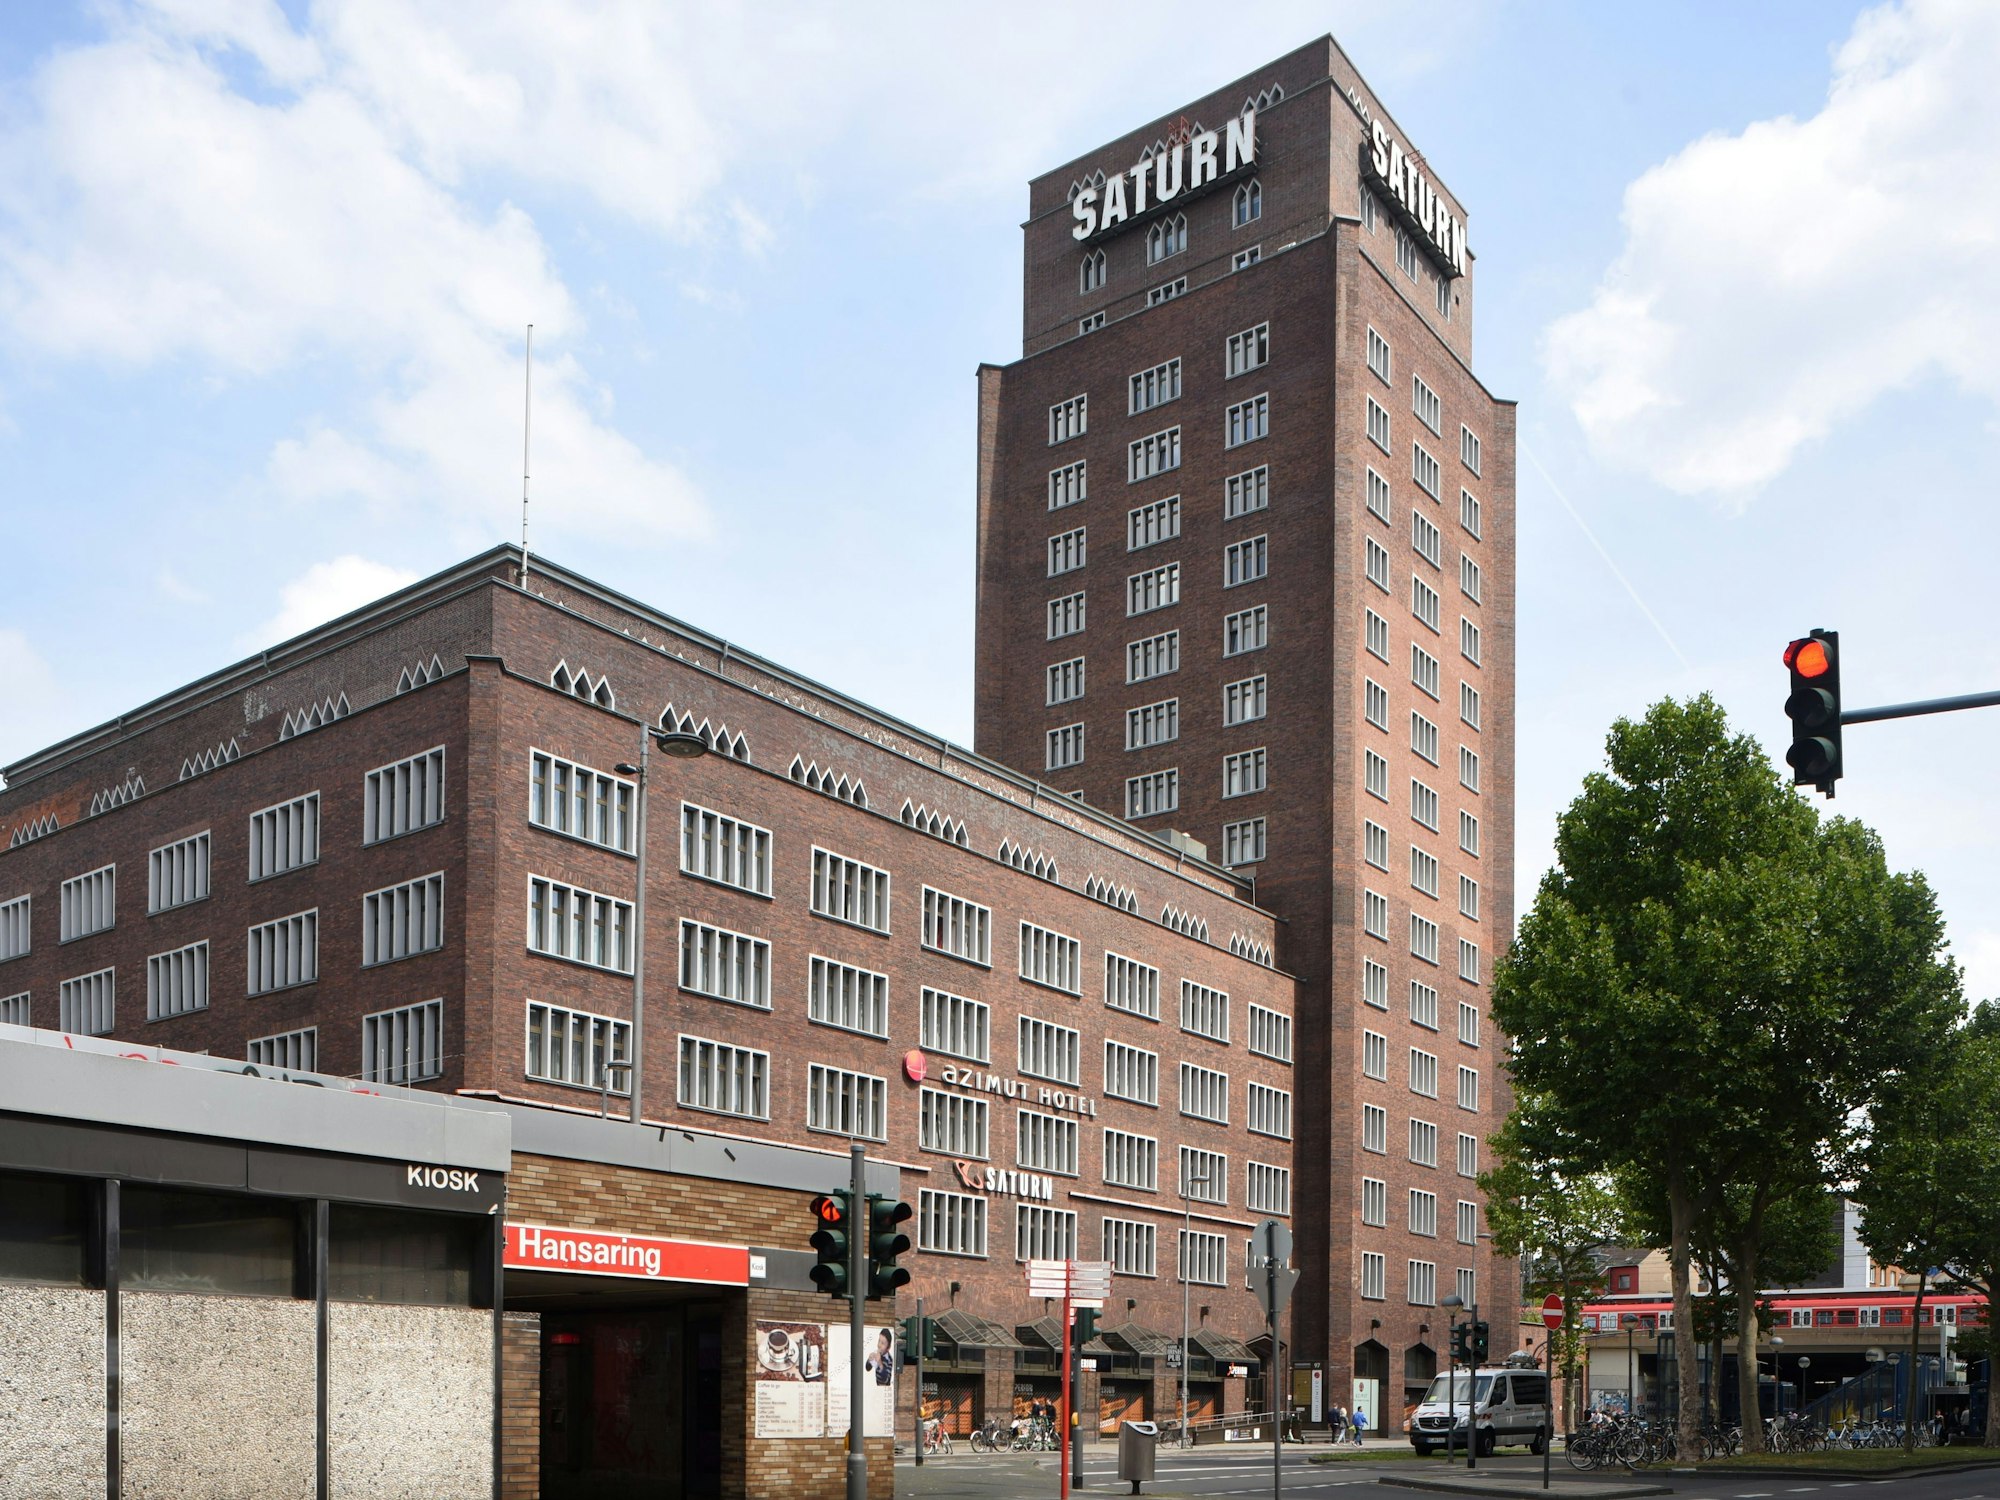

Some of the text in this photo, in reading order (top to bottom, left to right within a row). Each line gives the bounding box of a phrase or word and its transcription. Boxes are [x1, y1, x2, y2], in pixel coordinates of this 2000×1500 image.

[1072, 109, 1256, 241] SATURN
[1372, 119, 1466, 277] SATURN
[1038, 1087, 1097, 1117] HOTEL
[407, 1165, 480, 1193] KIOSK
[986, 1166, 1053, 1200] SATURN
[519, 1228, 661, 1275] Hansaring
[752, 1263, 764, 1271] Kiosk
[1167, 1354, 1181, 1362] PUB
